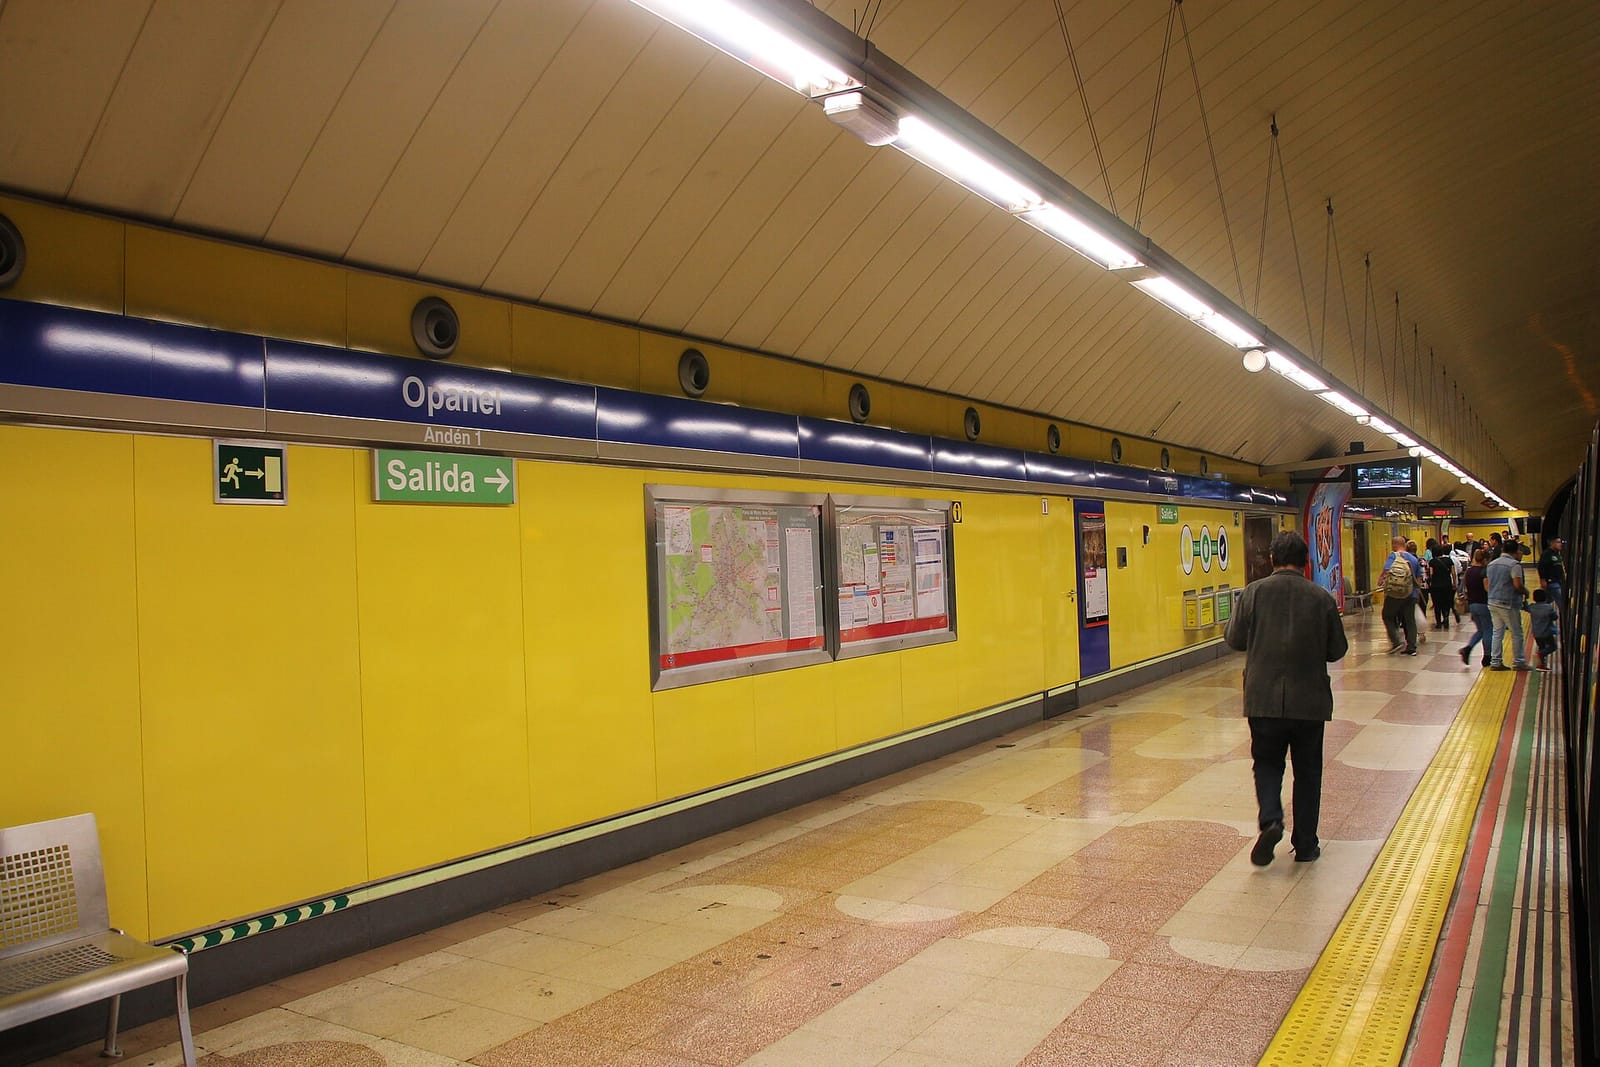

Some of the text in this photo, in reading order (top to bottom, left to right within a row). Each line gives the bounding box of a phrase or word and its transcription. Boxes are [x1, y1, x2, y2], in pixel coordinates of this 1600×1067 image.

[402, 376, 502, 416] Opañel
[424, 427, 481, 446] Andén 1
[387, 459, 475, 493] Salida
